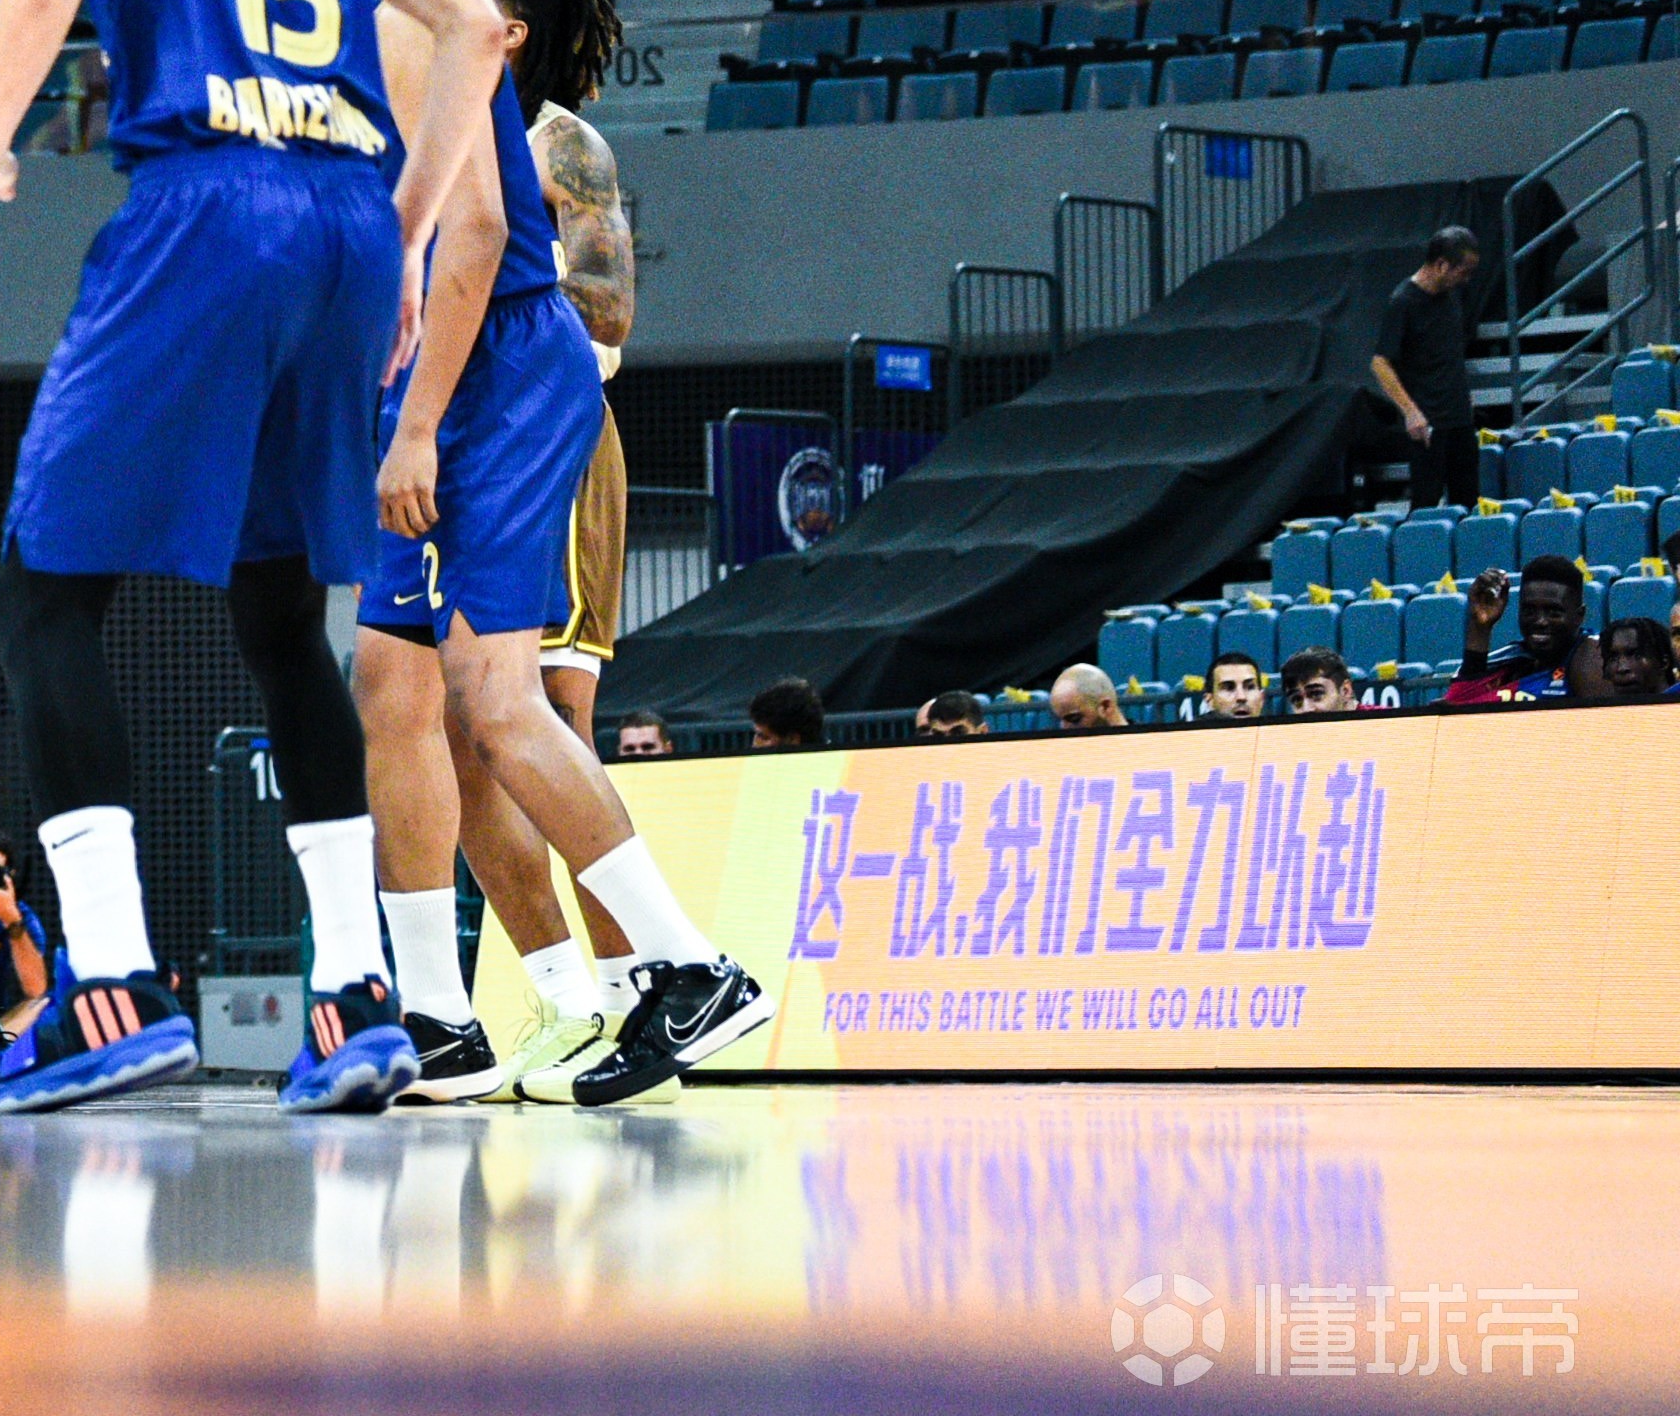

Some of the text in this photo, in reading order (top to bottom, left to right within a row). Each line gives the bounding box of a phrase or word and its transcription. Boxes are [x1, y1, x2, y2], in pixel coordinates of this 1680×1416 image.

[823, 984, 1308, 1033] FOR THIS BATTLE WE WILL GO ALL OUT
